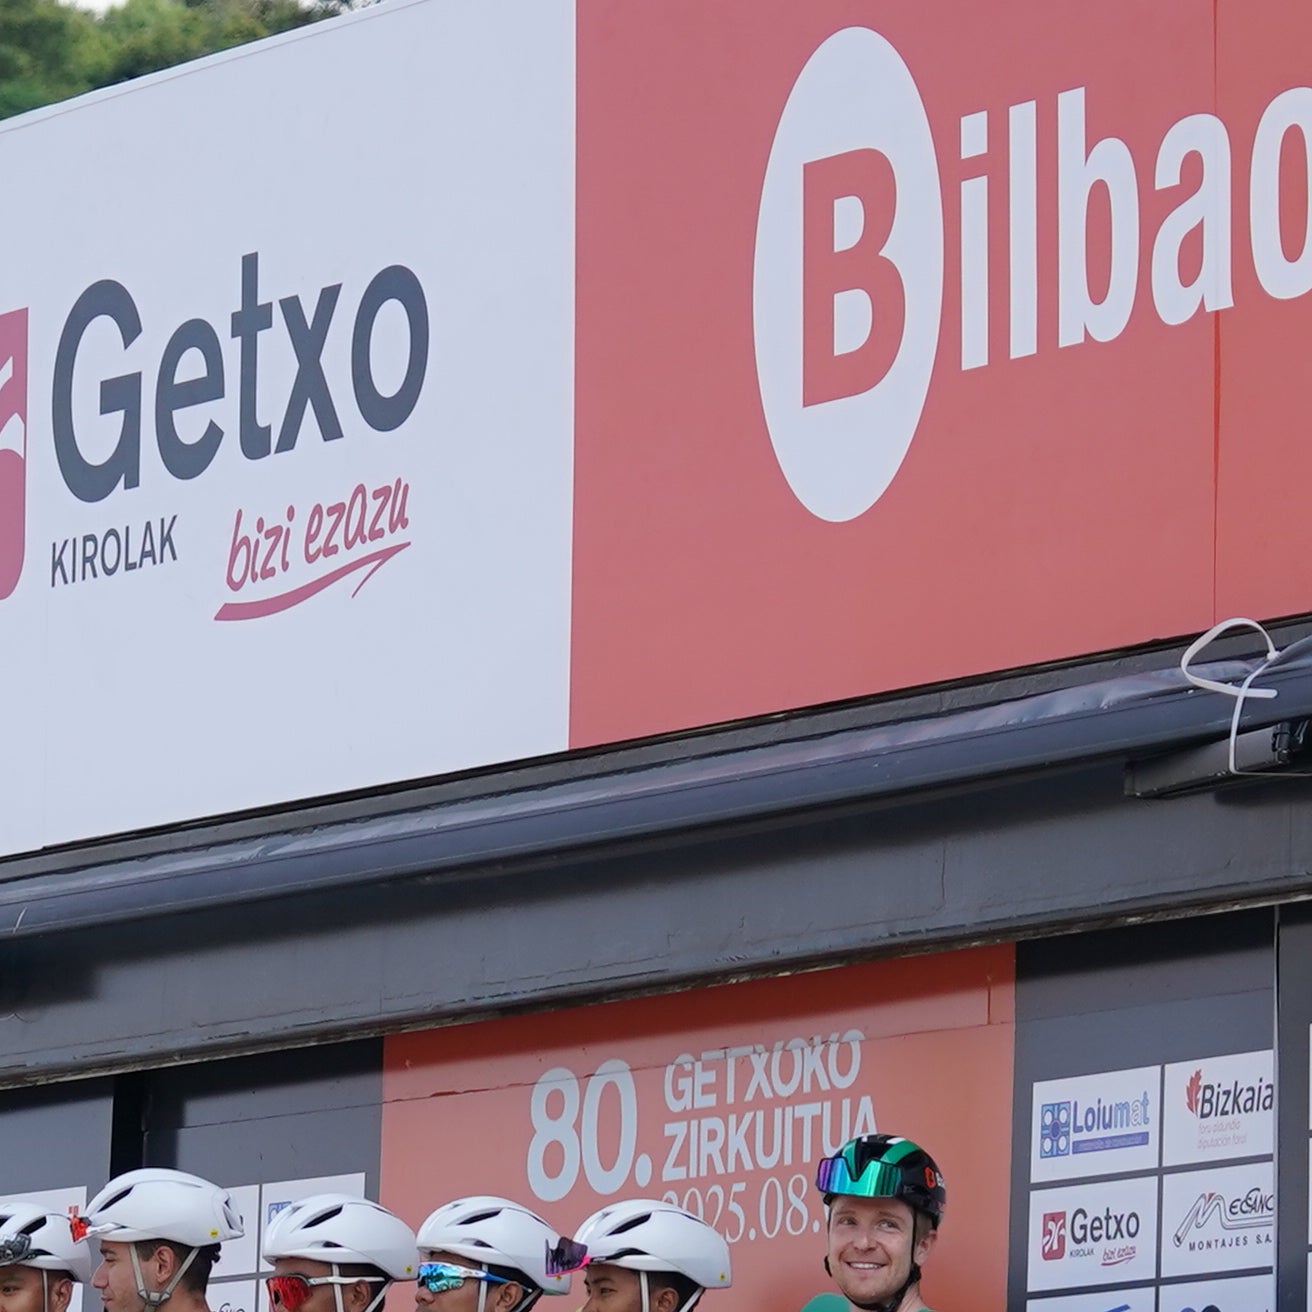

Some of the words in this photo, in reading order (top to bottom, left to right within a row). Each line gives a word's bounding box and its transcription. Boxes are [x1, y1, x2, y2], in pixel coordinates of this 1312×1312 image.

[51, 251, 430, 504] Getxo
[50, 515, 178, 588] KIROLAK
[225, 507, 294, 592] bizi
[304, 478, 411, 566] ezazu
[526, 1058, 653, 1202] 80.
[663, 1028, 867, 1113] GETXOKO
[1072, 1090, 1150, 1134] Loiumat
[1199, 1077, 1274, 1119] Bizkaia
[662, 1095, 879, 1182] ZIRKUITUA
[1070, 1206, 1140, 1245] Getxo
[1189, 1236, 1249, 1252] MONTAJES
